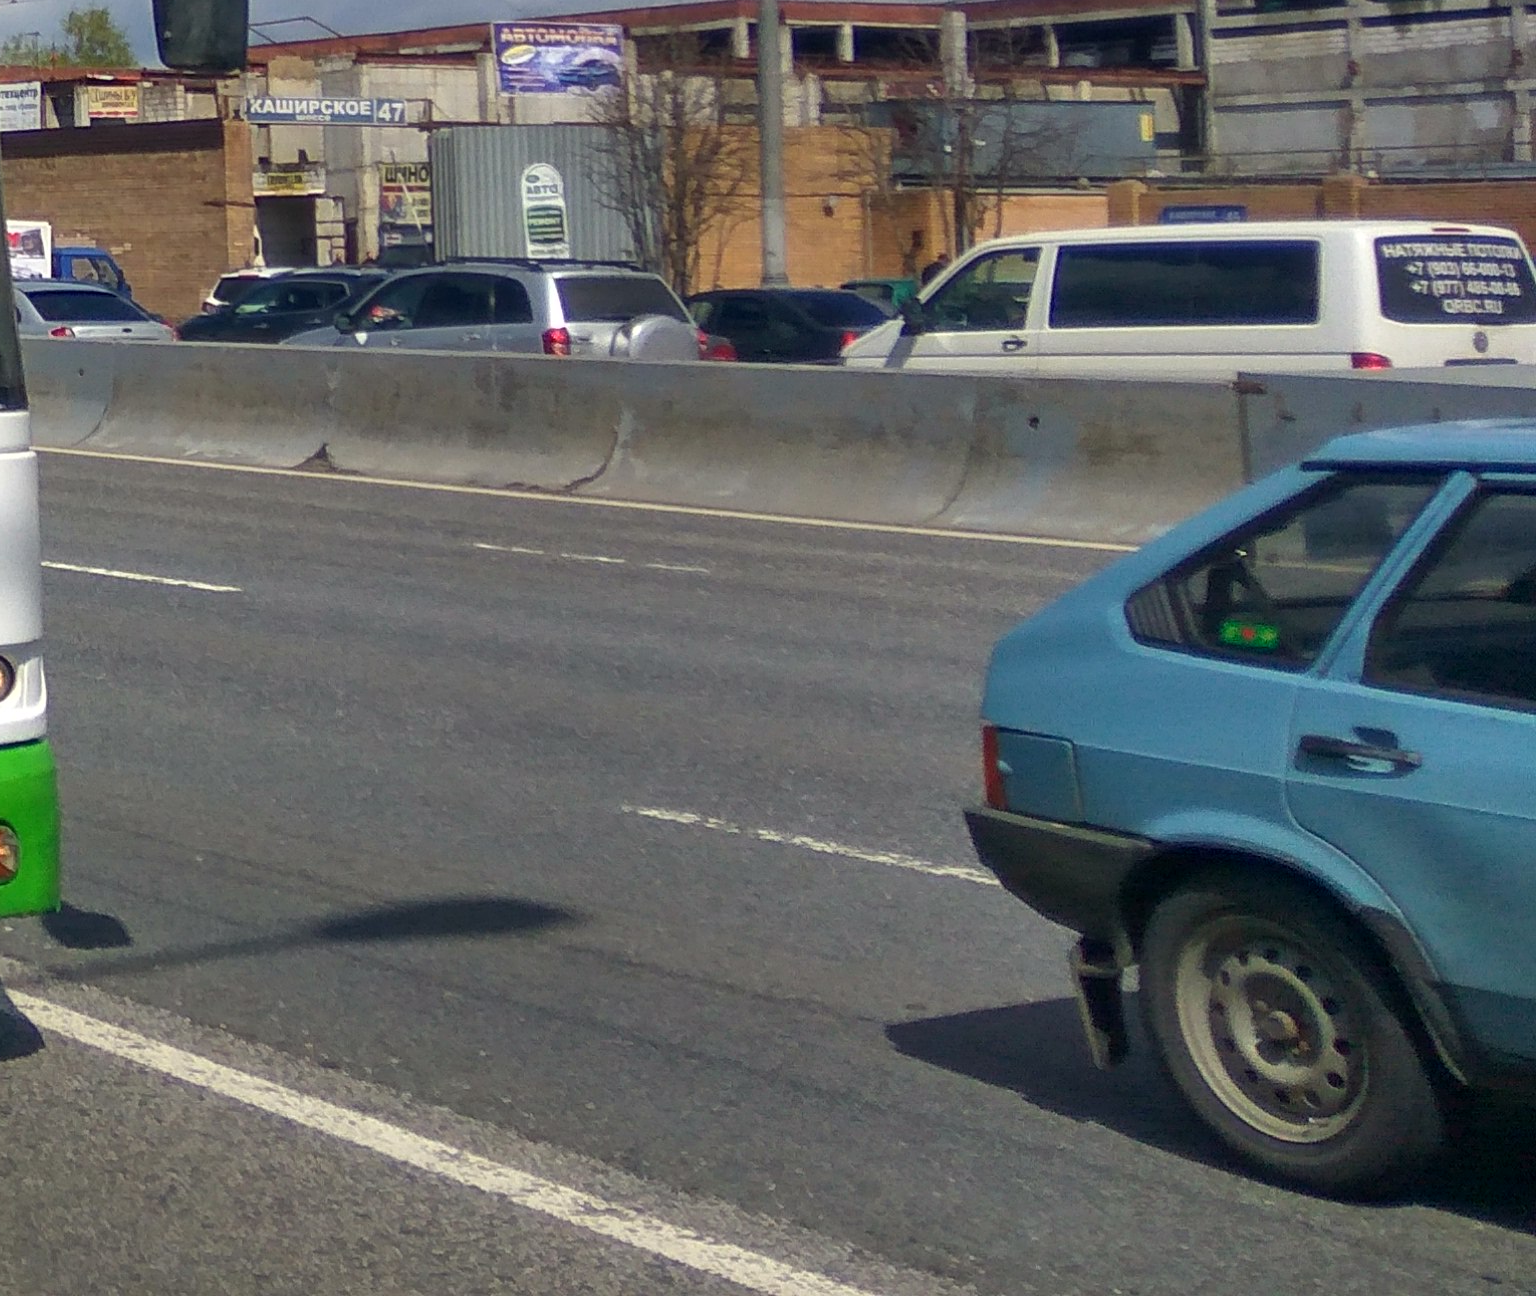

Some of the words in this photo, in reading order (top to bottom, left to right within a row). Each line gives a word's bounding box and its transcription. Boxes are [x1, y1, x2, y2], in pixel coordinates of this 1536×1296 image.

[249, 98, 371, 115] КАШИРСКОЕ
[378, 102, 403, 121] 47
[1382, 243, 1465, 258] НАТЯЖНЫЕ
[1405, 262, 1424, 275] +7
[1410, 280, 1429, 294] +7
